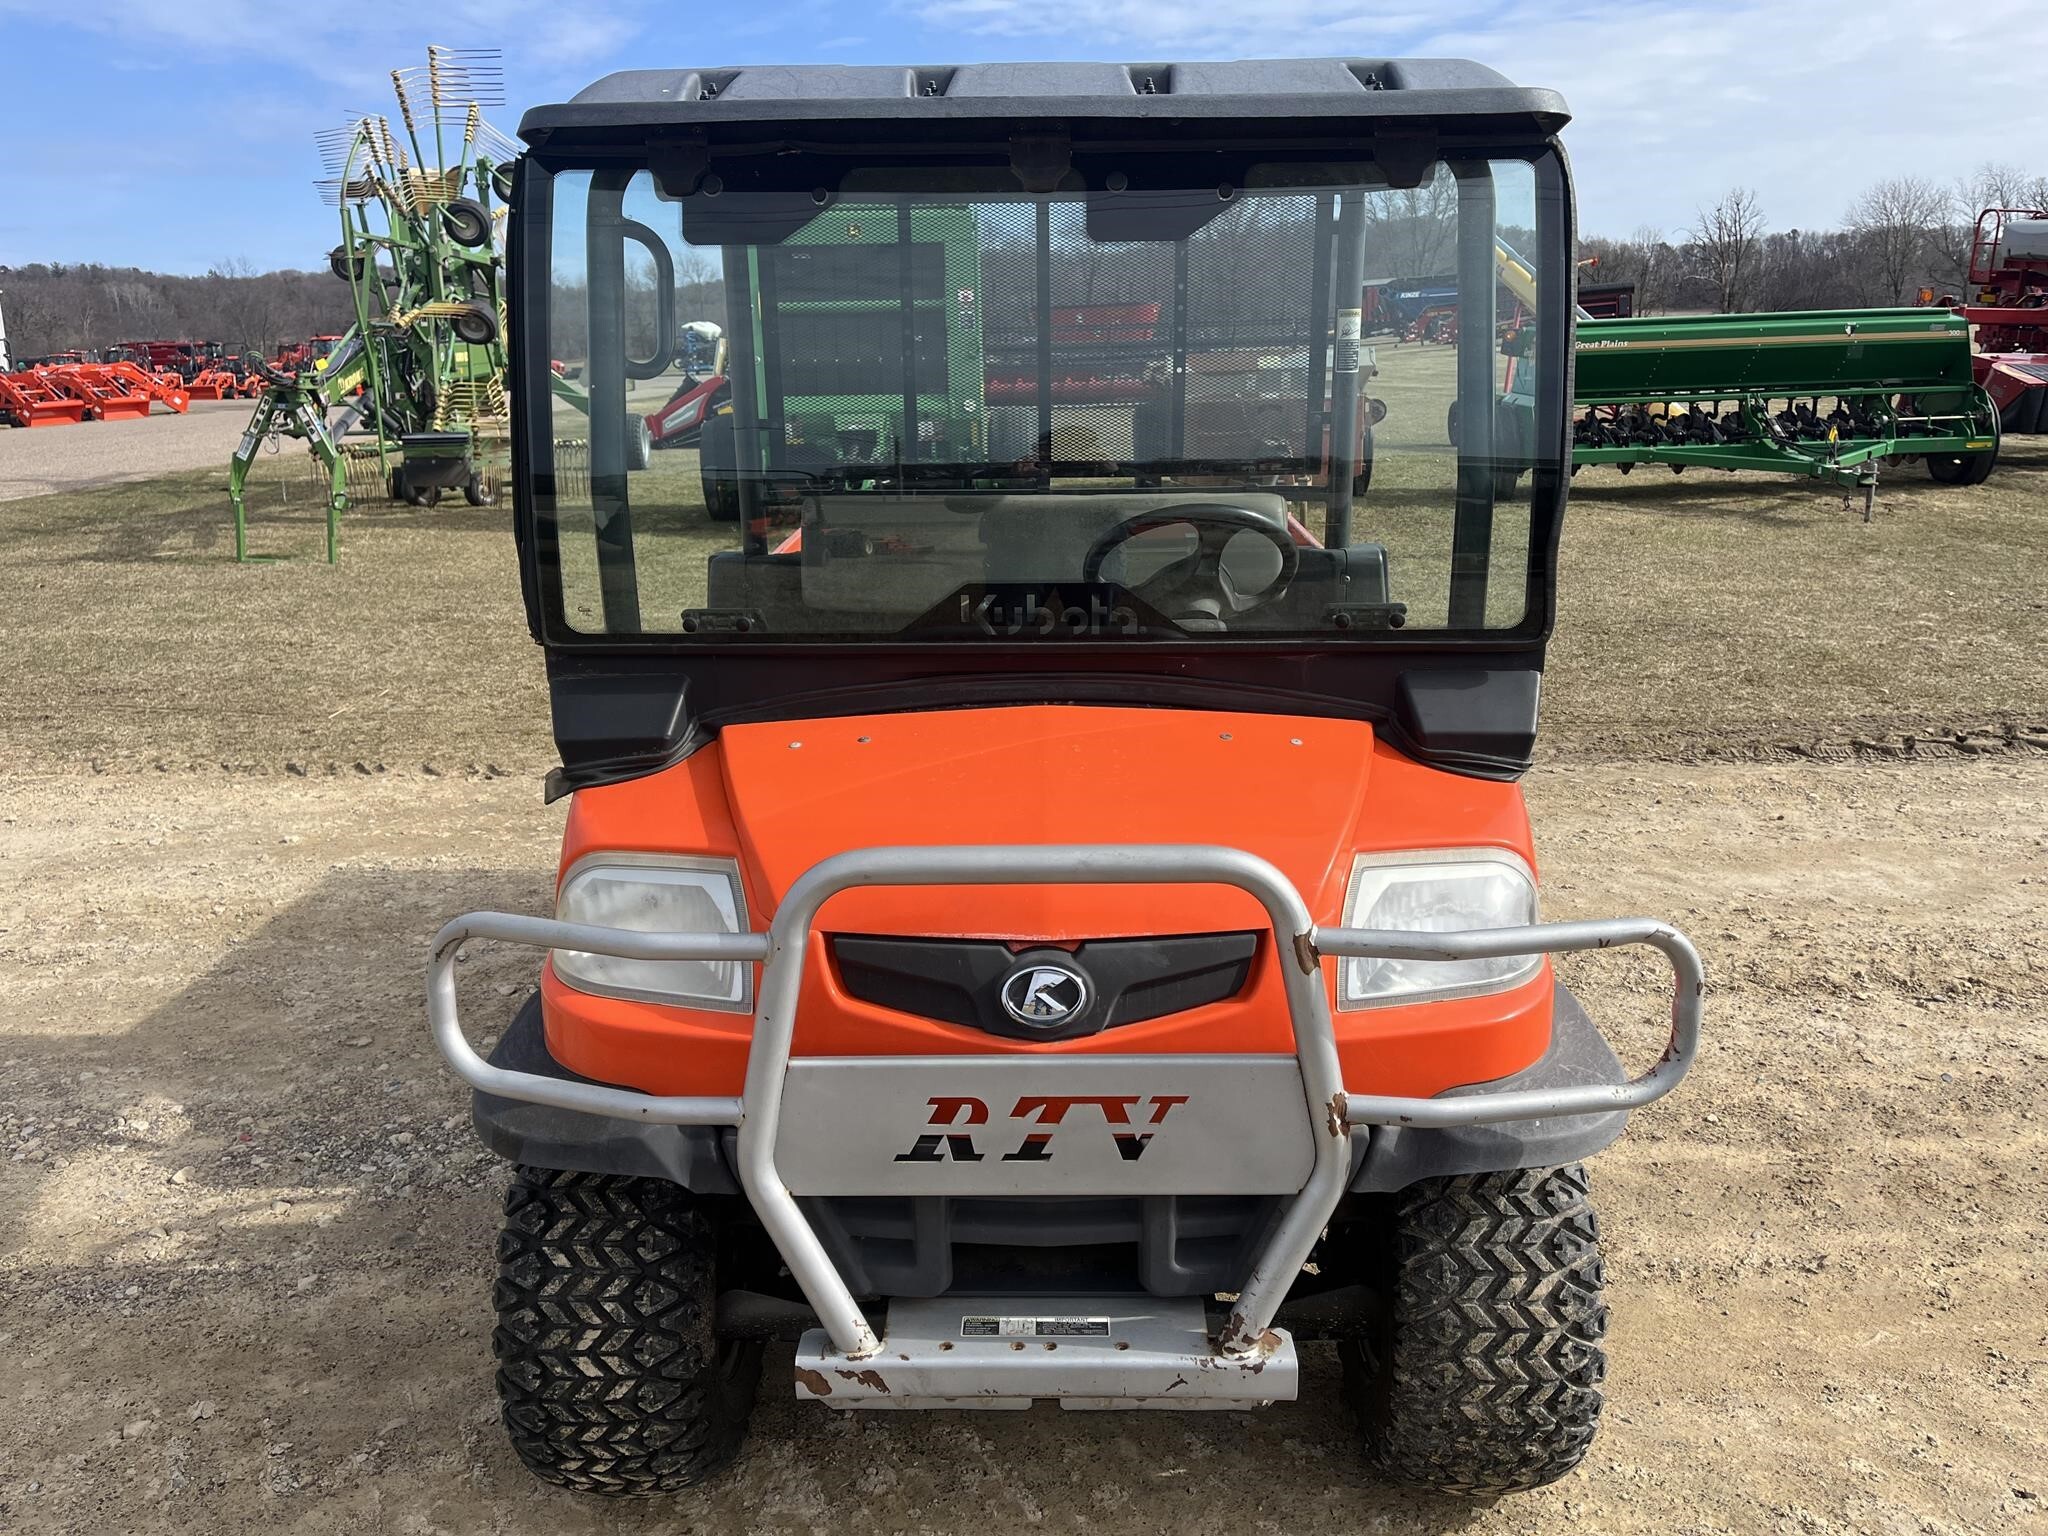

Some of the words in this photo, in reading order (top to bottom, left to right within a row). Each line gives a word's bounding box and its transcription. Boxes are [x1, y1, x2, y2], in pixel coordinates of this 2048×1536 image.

[1575, 341, 1599, 349] Great
[1600, 339, 1629, 348] Plains
[959, 593, 1139, 636] Kubota
[893, 1095, 1190, 1162] RTV
